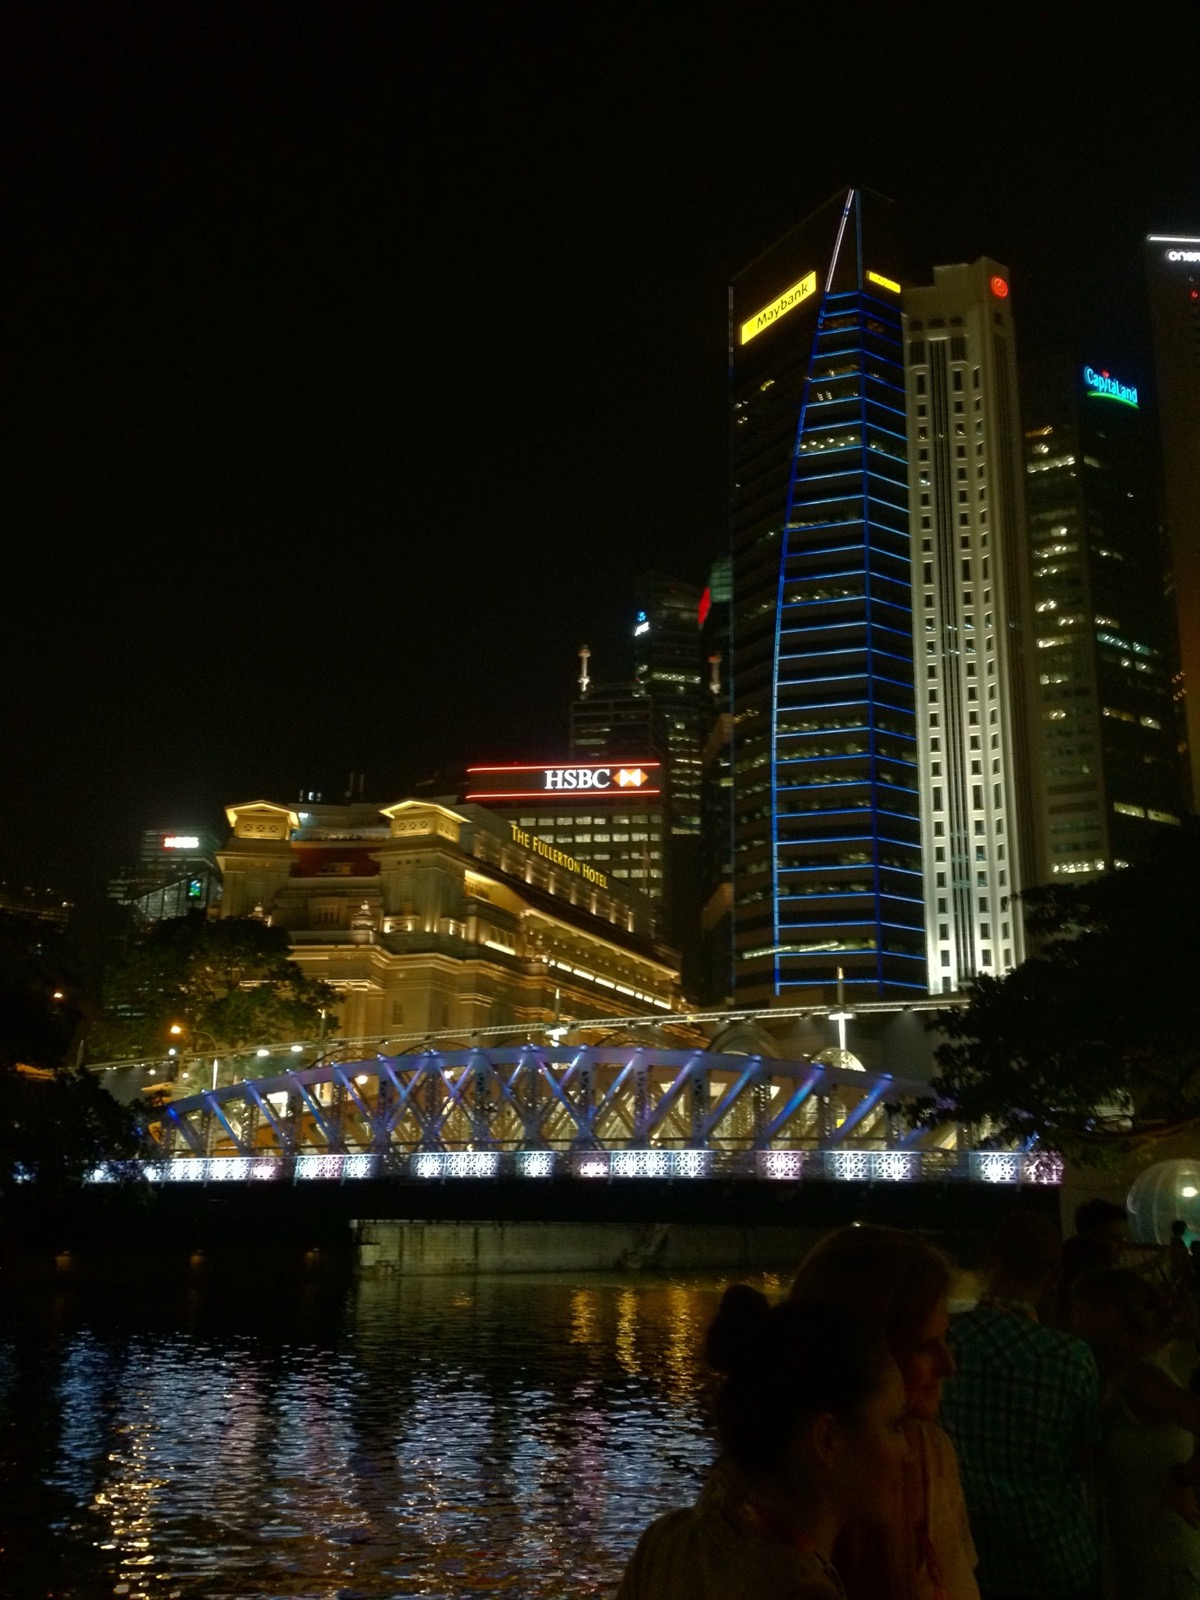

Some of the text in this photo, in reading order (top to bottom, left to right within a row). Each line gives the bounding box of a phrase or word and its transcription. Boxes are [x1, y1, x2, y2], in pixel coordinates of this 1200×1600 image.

[756, 283, 809, 329] Maybank
[1084, 366, 1138, 403] CapitaLand
[544, 769, 611, 790] HSBC
[511, 825, 608, 889] THE FULLERTON HOTEL
